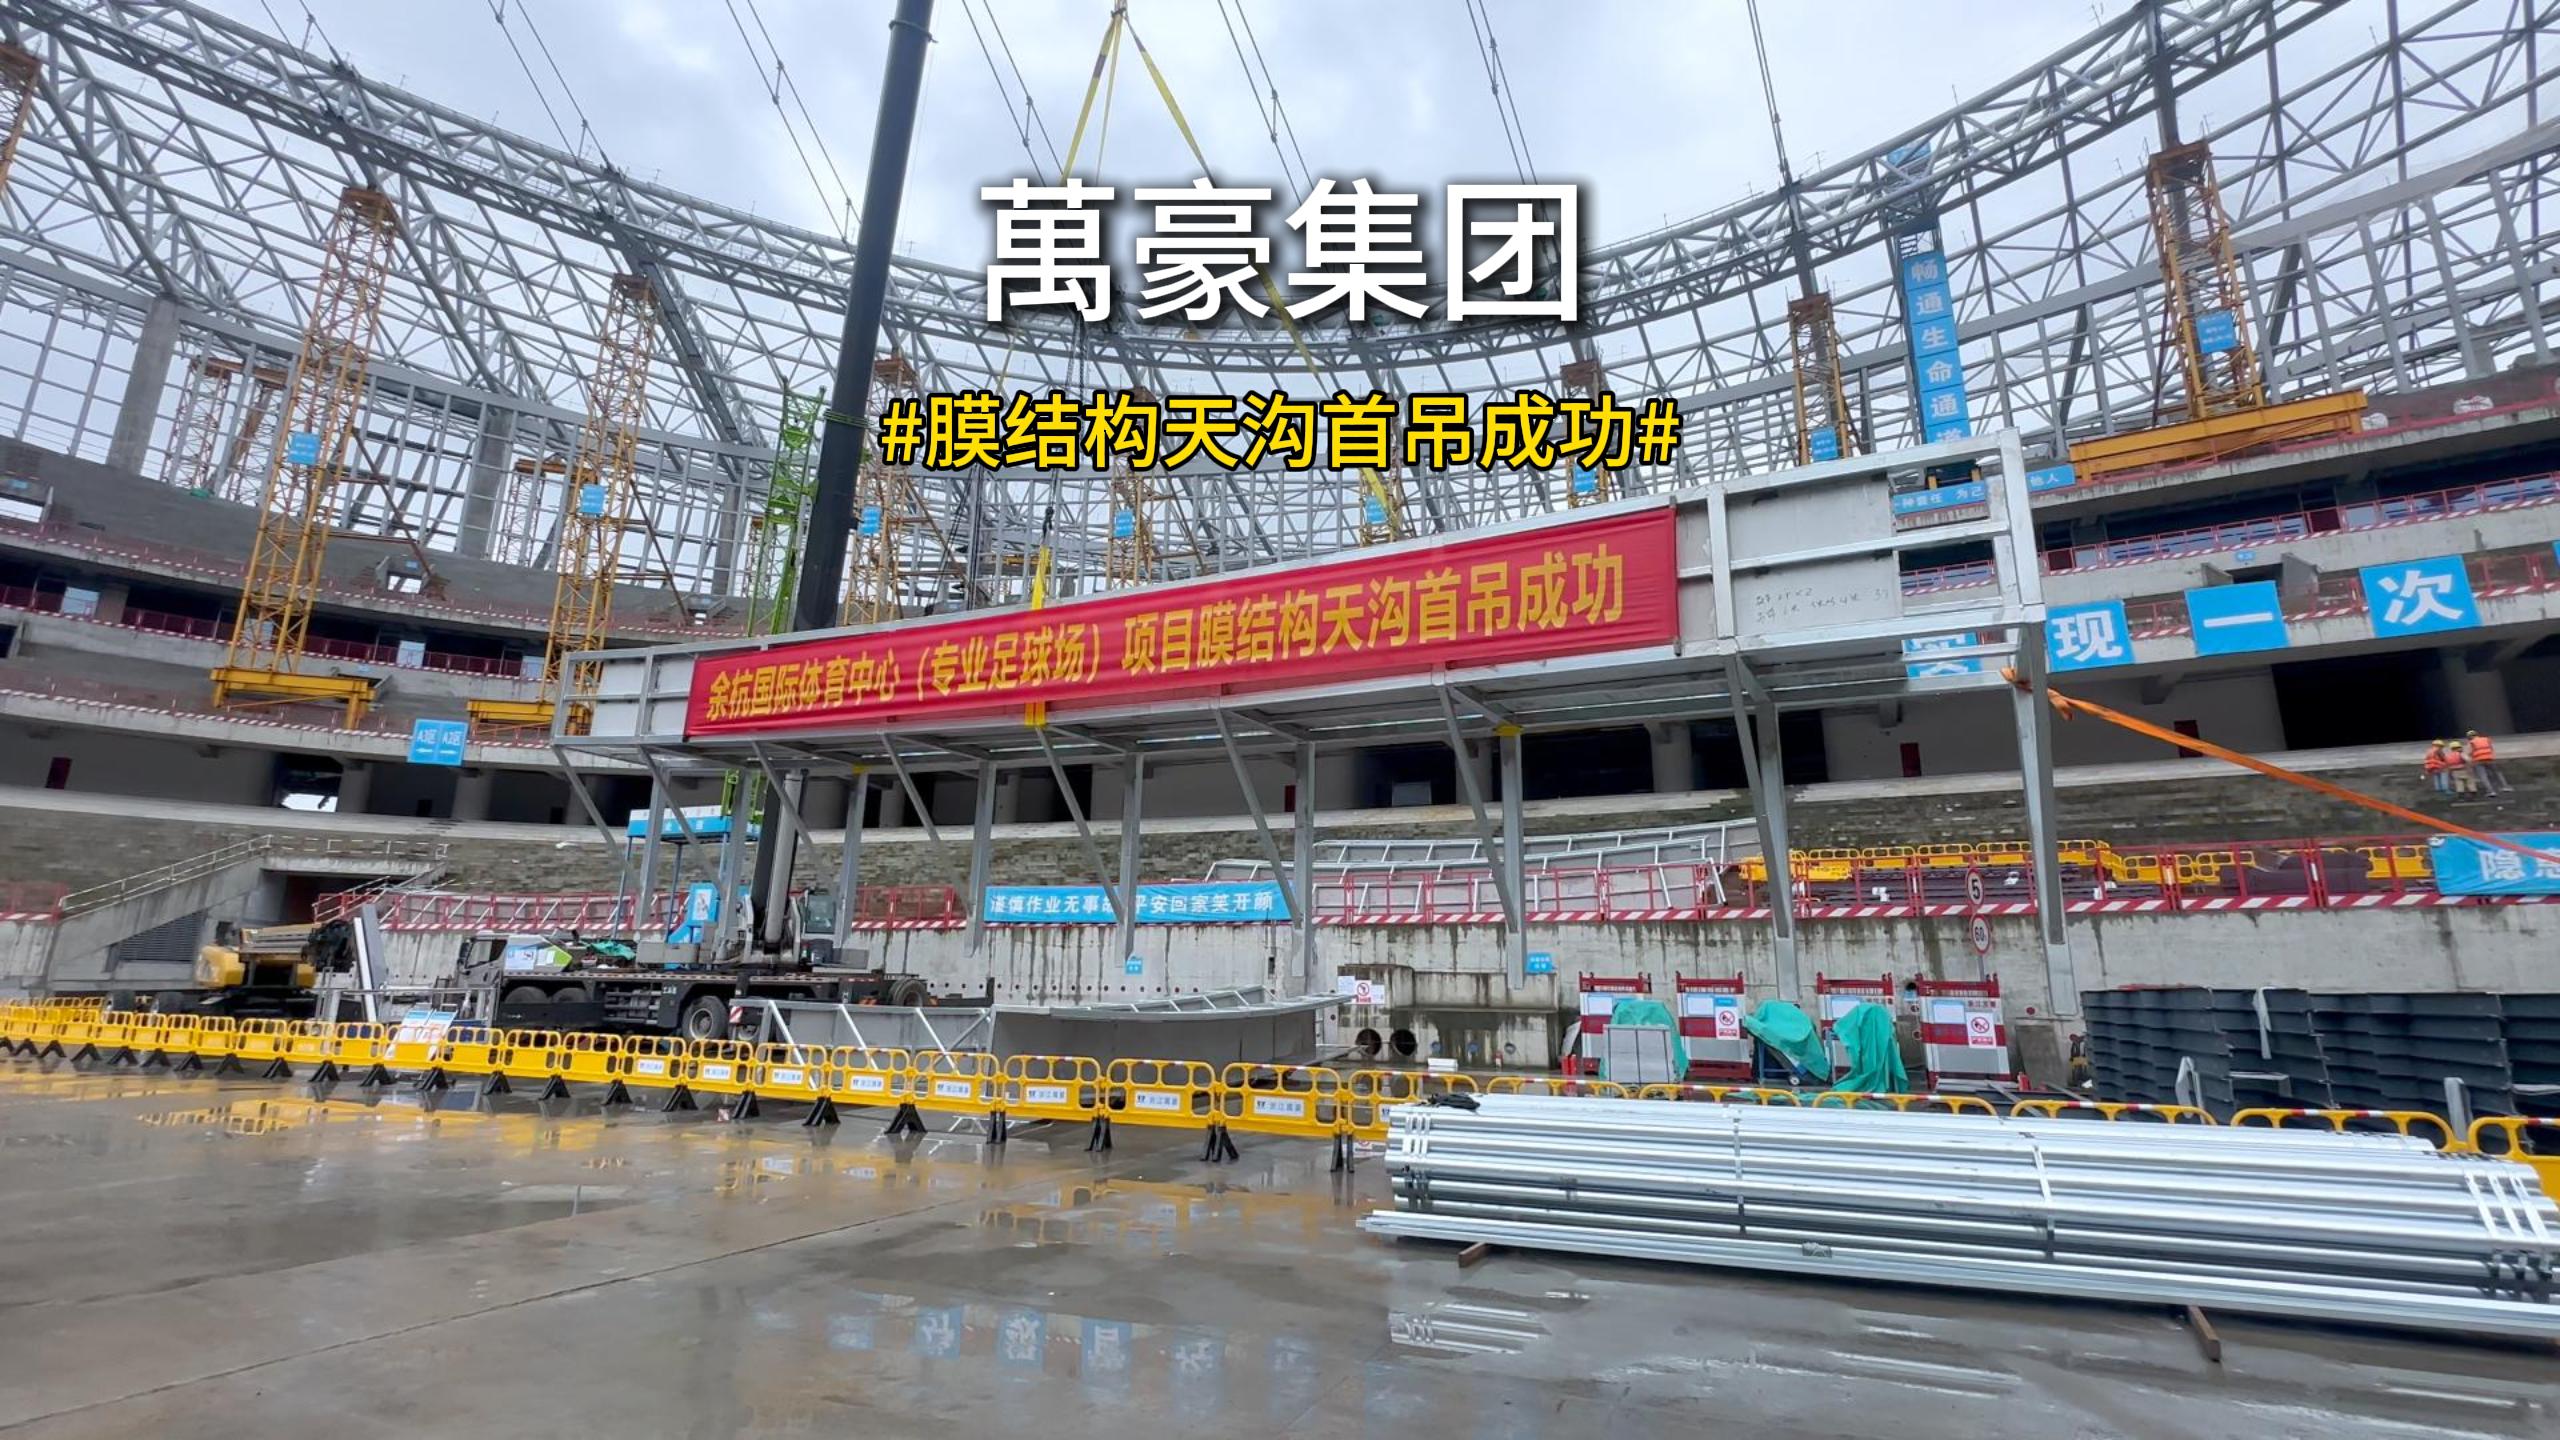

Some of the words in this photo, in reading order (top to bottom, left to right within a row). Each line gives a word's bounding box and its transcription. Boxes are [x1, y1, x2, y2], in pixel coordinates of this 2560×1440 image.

[2053, 610, 2123, 661] 现
[2378, 570, 2463, 625] 次
[1971, 878, 1981, 900] 5
